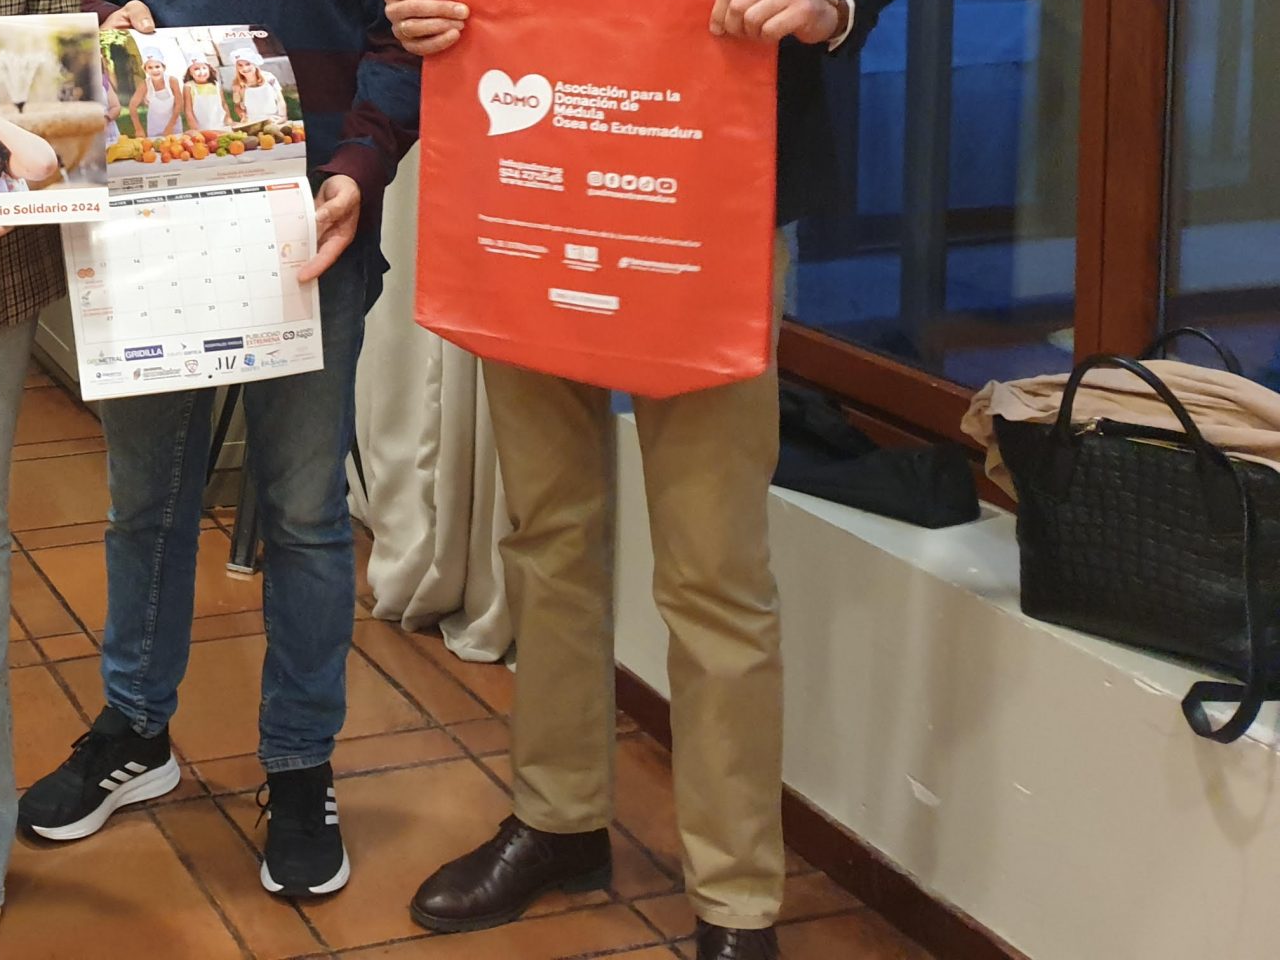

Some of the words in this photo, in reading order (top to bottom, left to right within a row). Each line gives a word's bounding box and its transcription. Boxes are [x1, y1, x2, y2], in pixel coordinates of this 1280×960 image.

[224, 30, 268, 38] MAYO
[554, 81, 628, 99] Asociación
[630, 90, 663, 103] para
[666, 89, 681, 102] la
[490, 92, 540, 109] ADMO
[554, 93, 619, 110] Donación
[620, 99, 639, 112] de
[553, 105, 605, 120] Médula
[590, 119, 609, 132] de
[610, 122, 703, 140] Extremadura
[13, 204, 68, 215] Solidario
[71, 202, 101, 212] 2024
[125, 348, 163, 359] GRIDILLA
